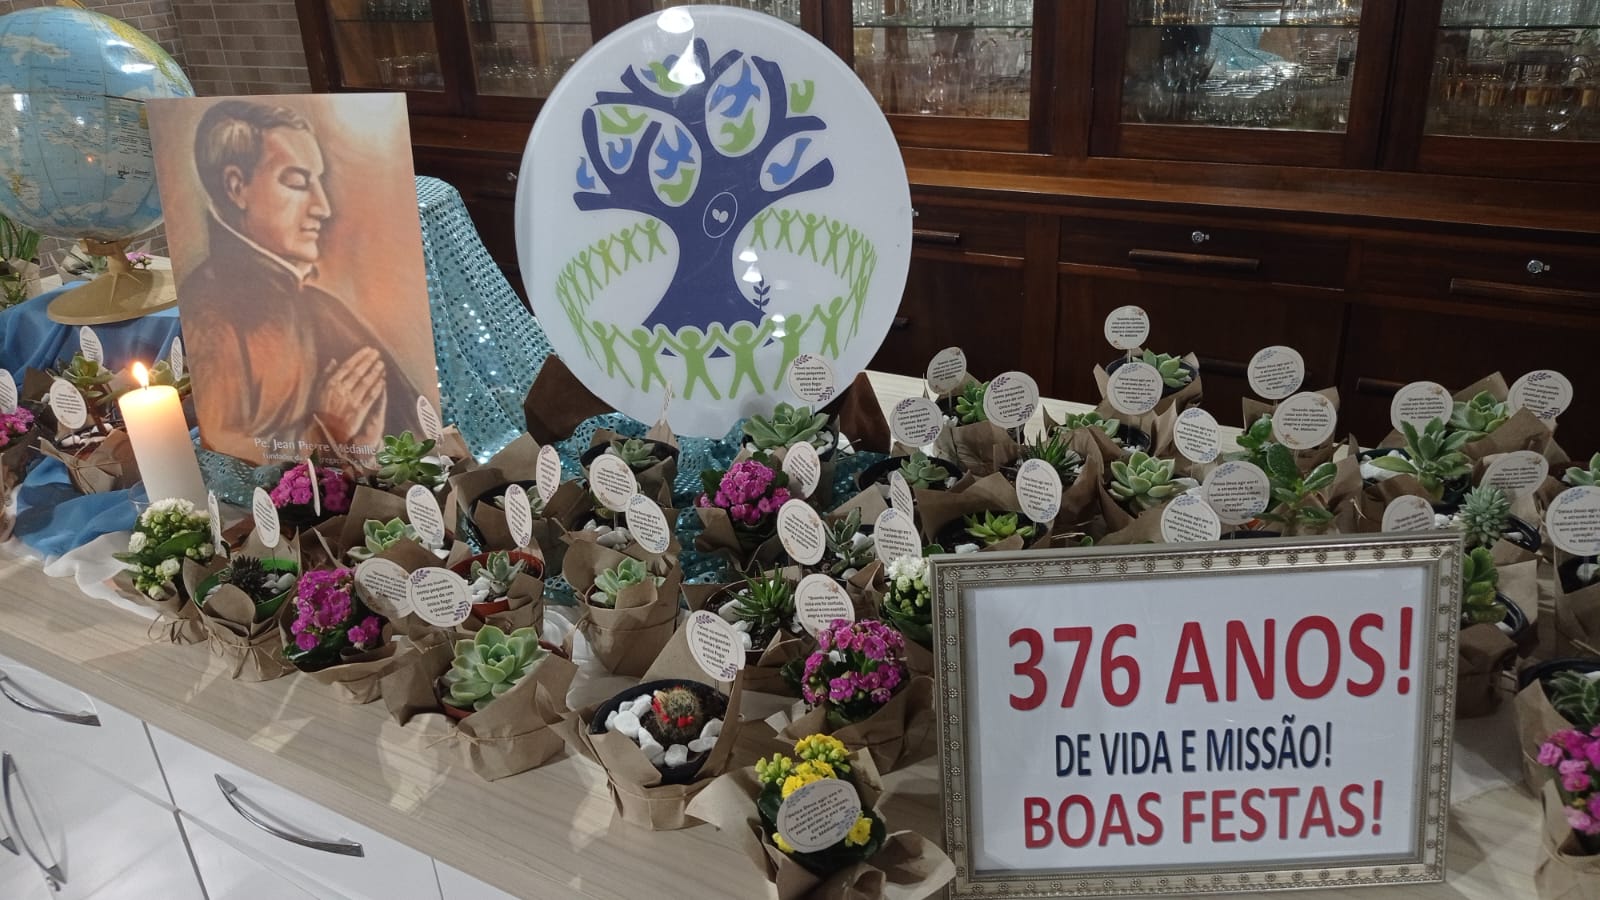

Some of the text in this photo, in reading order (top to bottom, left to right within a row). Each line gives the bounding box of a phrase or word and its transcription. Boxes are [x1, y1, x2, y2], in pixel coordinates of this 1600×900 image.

[254, 437, 271, 448] Pe.
[273, 438, 295, 451] Jean
[1008, 607, 1413, 711] 376 ANOS!
[1055, 714, 1332, 777] DE VIDA E MISSÃO!
[1023, 780, 1384, 849] BOAS FESTAS!
